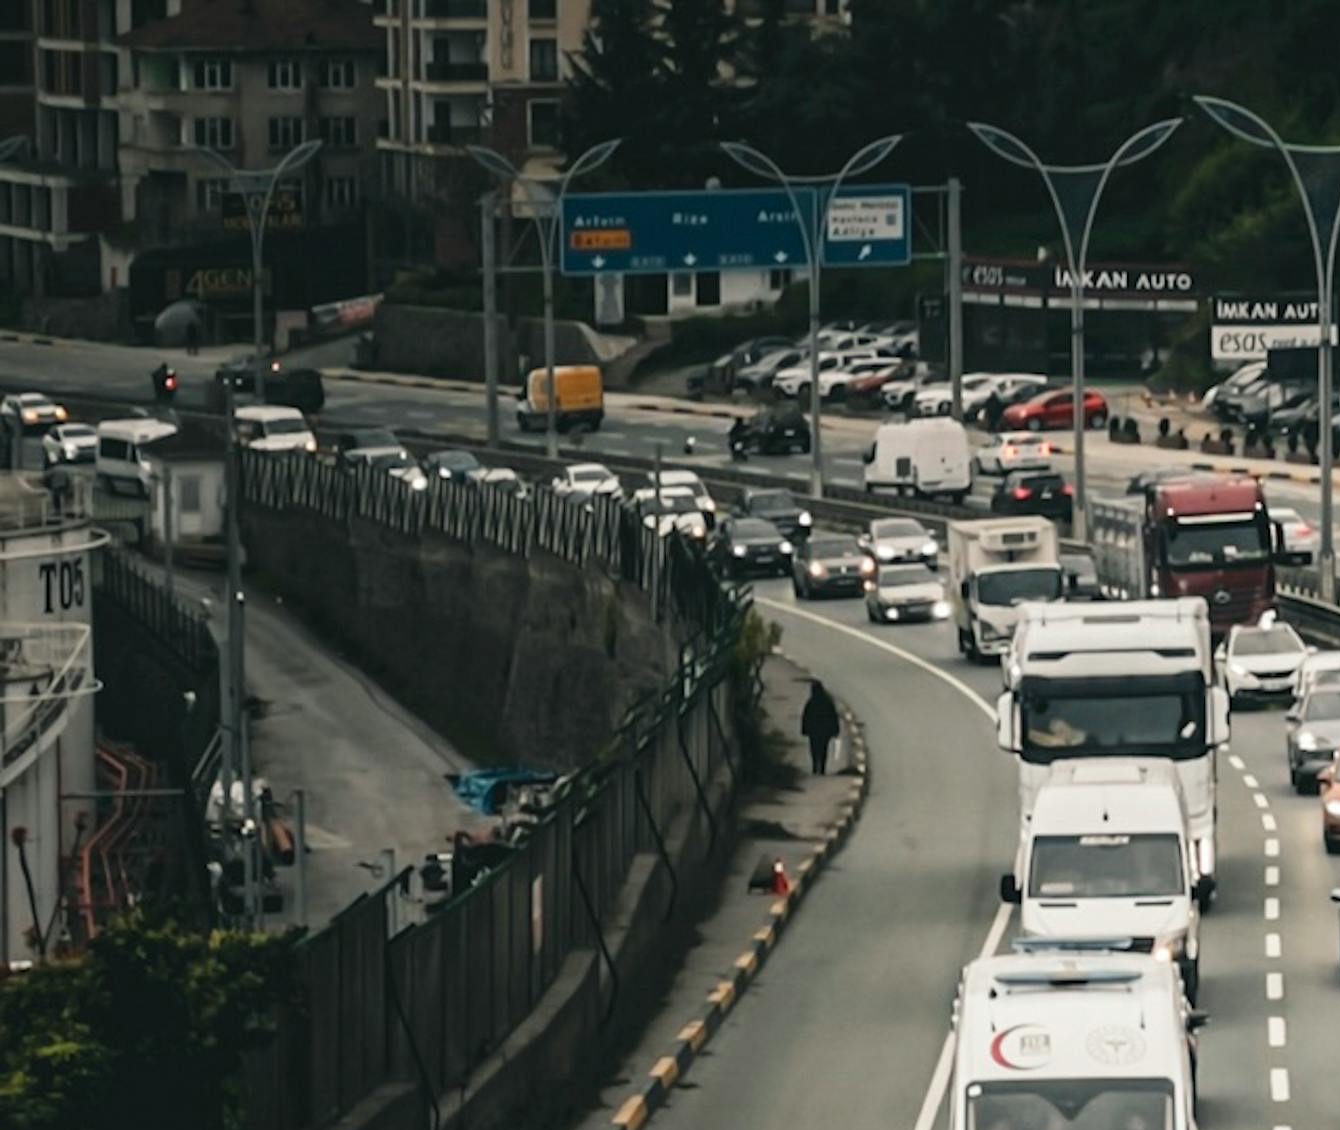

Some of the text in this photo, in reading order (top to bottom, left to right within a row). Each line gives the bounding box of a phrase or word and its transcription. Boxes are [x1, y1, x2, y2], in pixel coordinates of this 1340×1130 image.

[1135, 272, 1193, 291] AUTO
[1220, 332, 1267, 352] esas
[39, 557, 85, 613] T05
